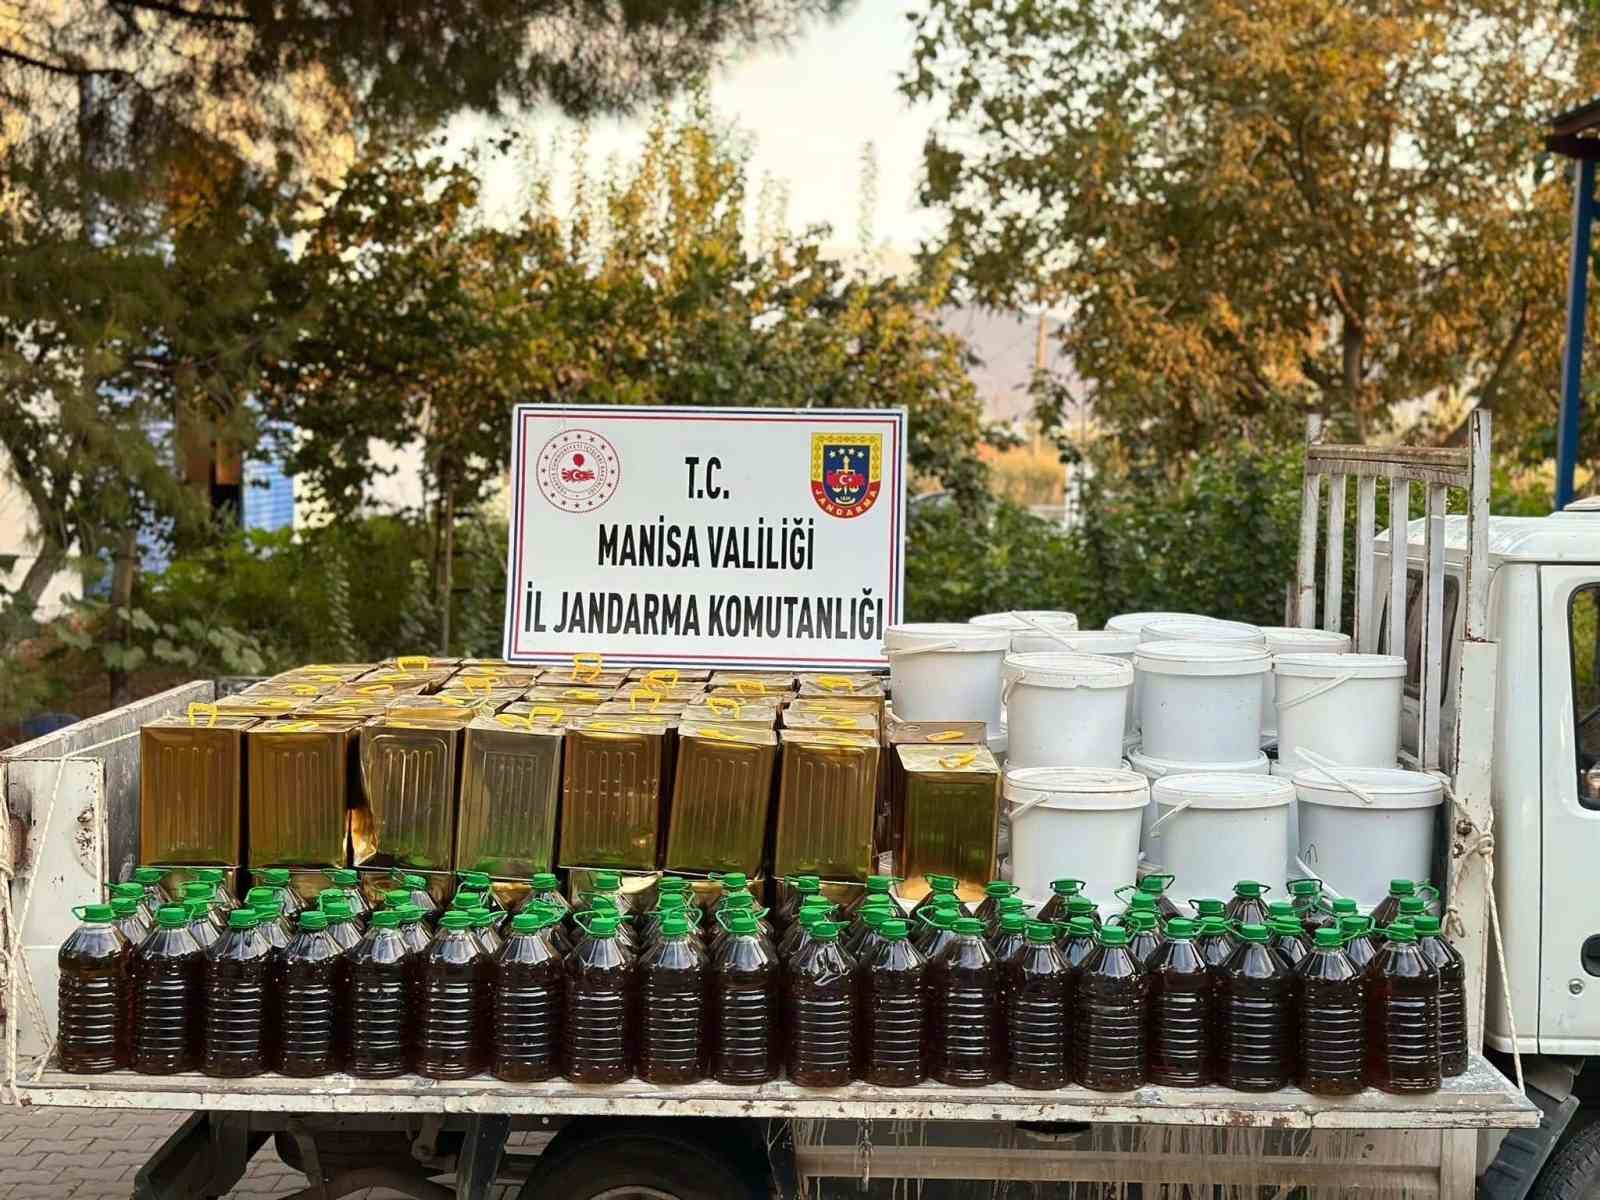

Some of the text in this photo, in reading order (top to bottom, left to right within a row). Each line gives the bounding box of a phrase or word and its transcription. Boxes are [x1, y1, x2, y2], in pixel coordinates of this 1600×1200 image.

[685, 457, 730, 499] T.C.
[814, 484, 878, 516] JANDARMA
[599, 515, 814, 570] MANİSA VALİLİĞİ
[525, 581, 883, 640] İL JANDARMA KOMUTANLIĞI
